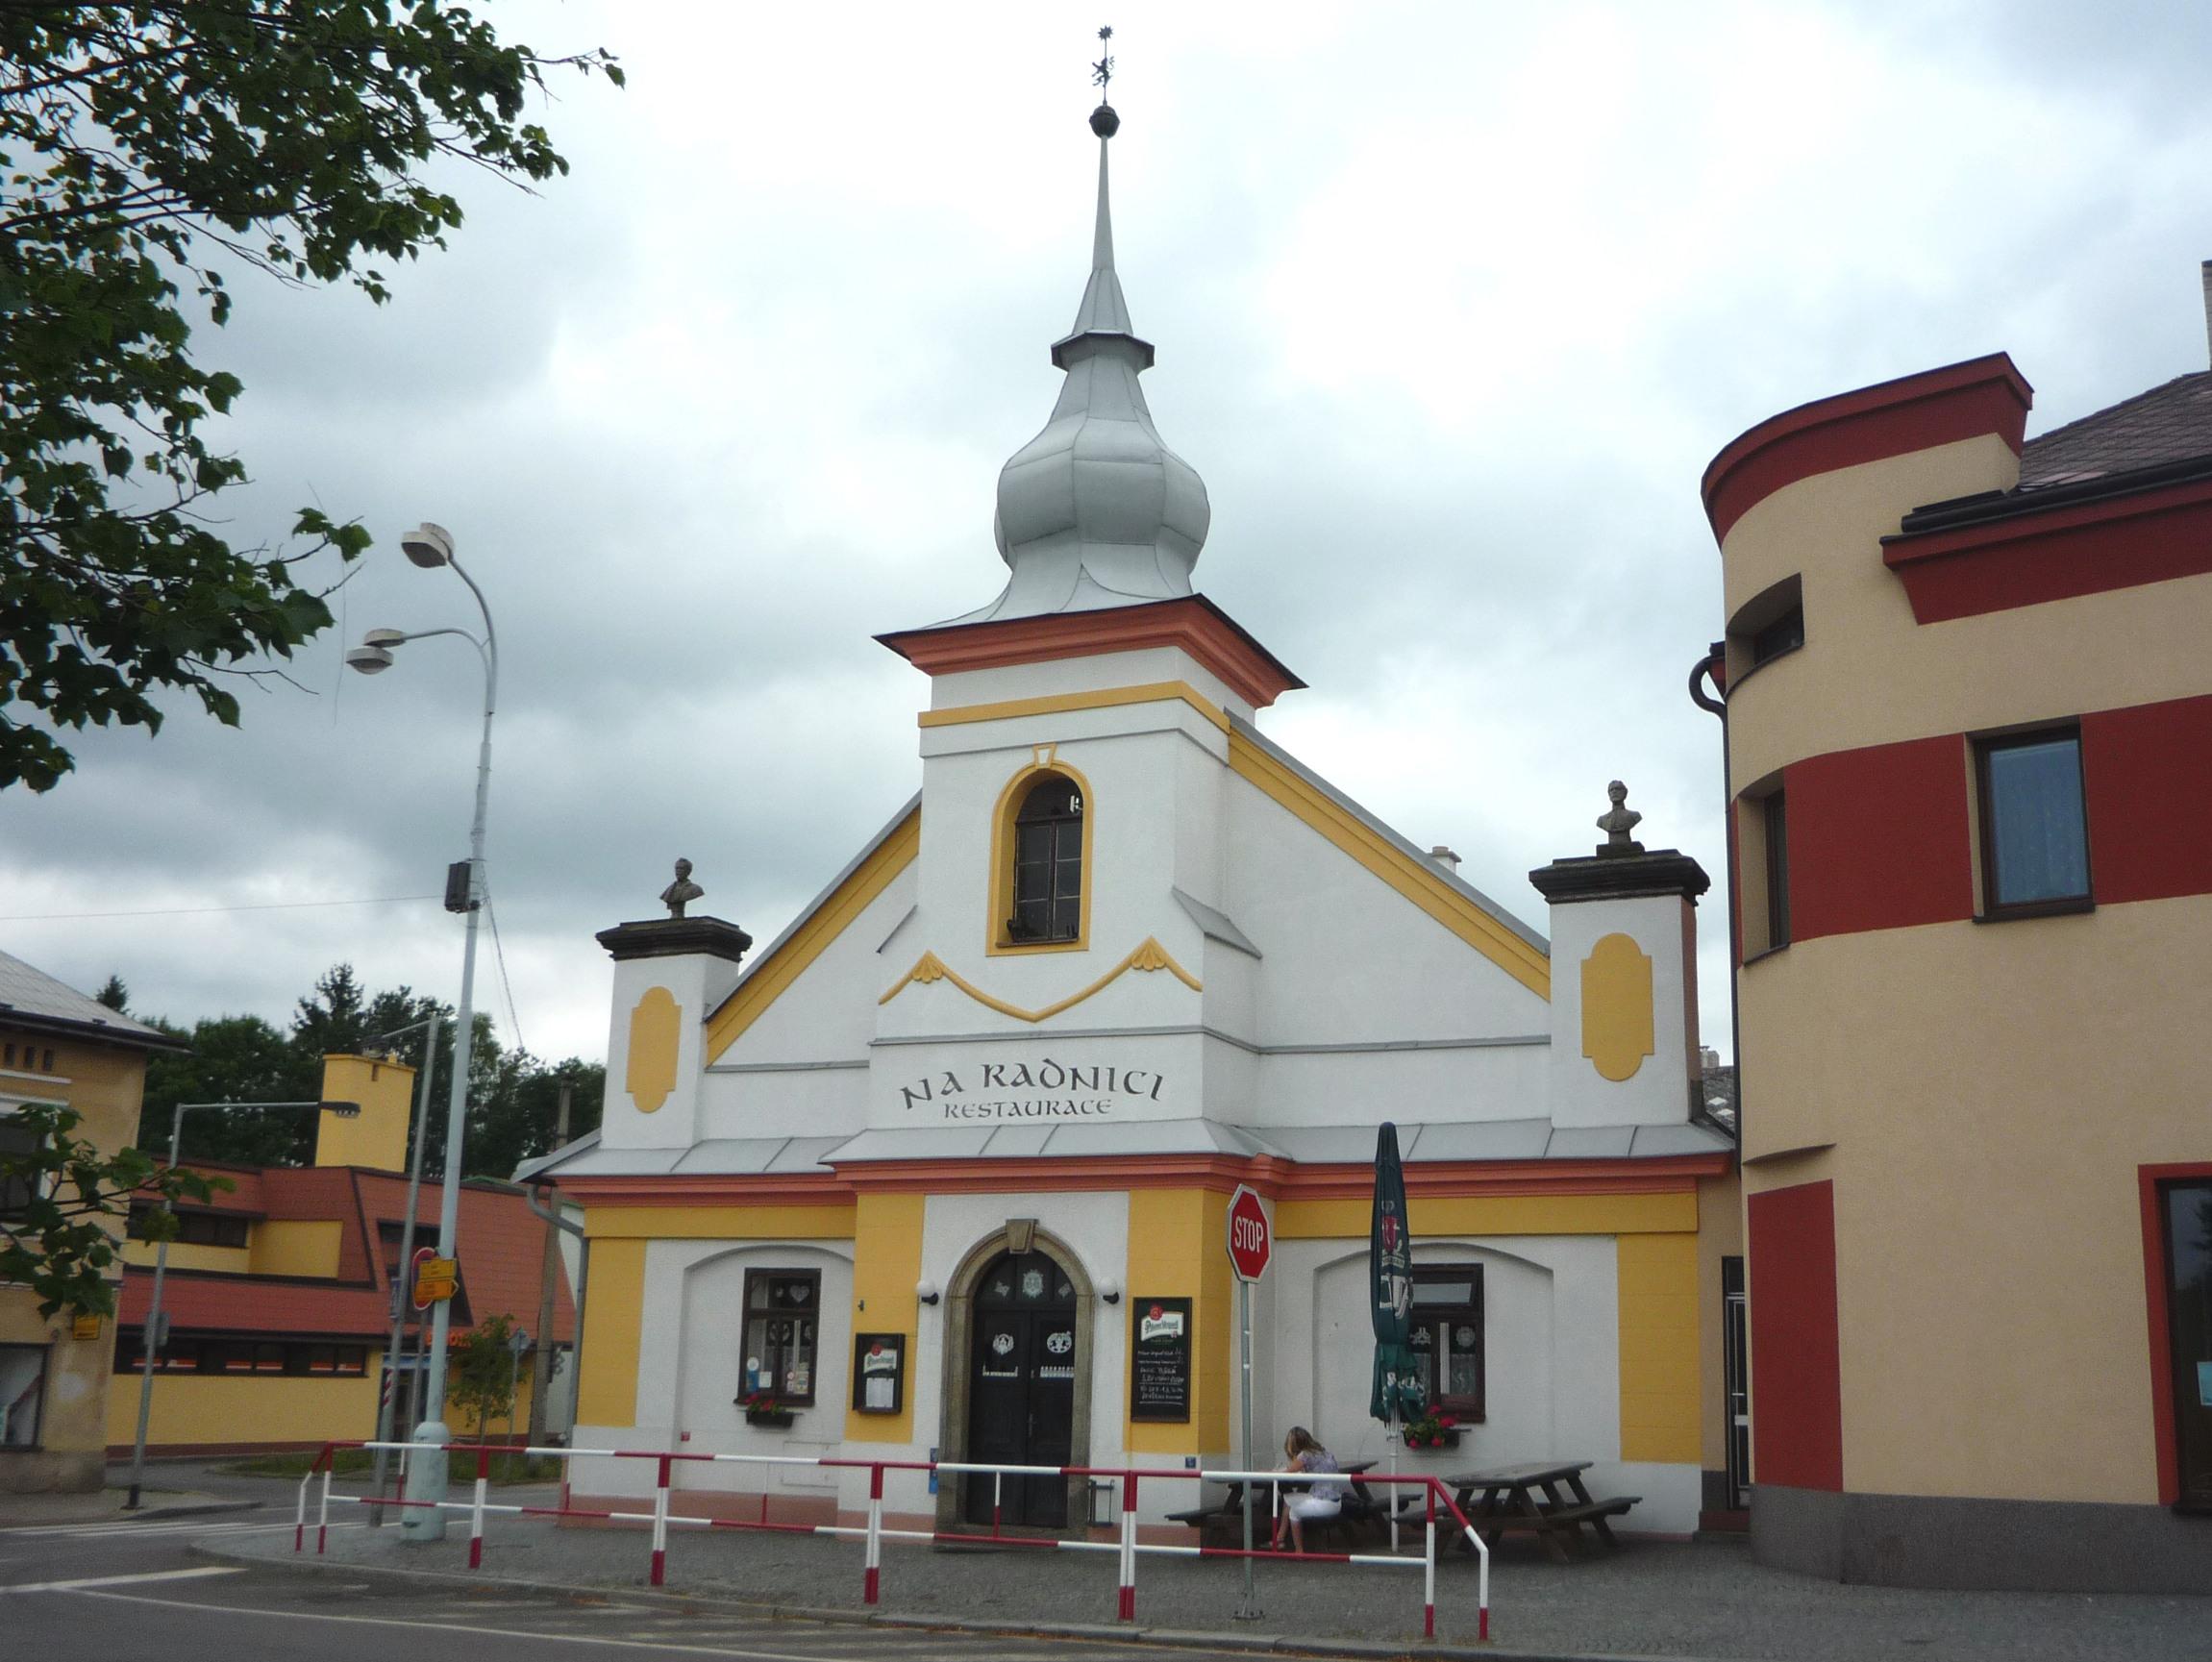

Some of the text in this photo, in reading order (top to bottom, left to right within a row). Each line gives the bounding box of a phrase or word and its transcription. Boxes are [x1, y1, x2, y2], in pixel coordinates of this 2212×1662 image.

[900, 1058, 1163, 1109] NA RADNICI
[944, 1099, 1112, 1118] RESTAURACE
[1234, 1215, 1264, 1253] STOP
